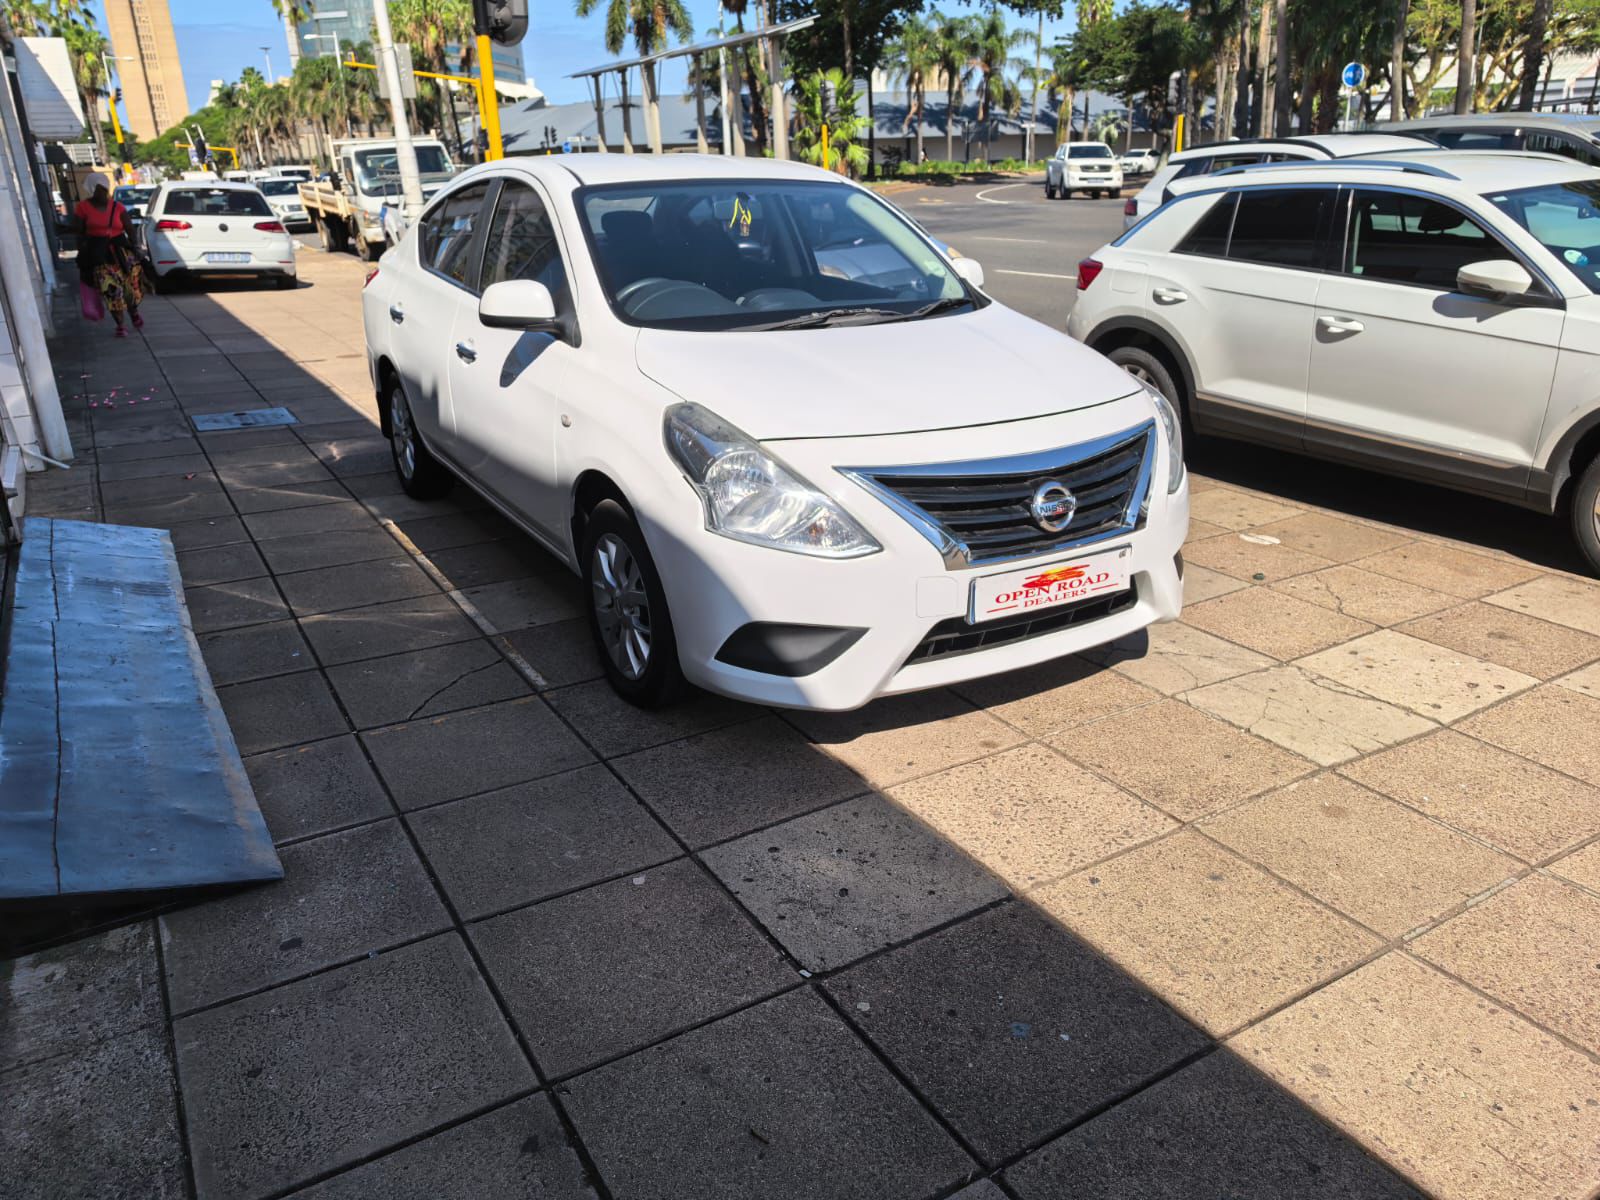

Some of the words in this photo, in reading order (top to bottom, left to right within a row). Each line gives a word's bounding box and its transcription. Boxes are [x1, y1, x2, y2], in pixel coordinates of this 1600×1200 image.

[995, 584, 1053, 604] OPEN
[1057, 572, 1109, 592] ROAD
[1024, 588, 1088, 608] DEALERS
